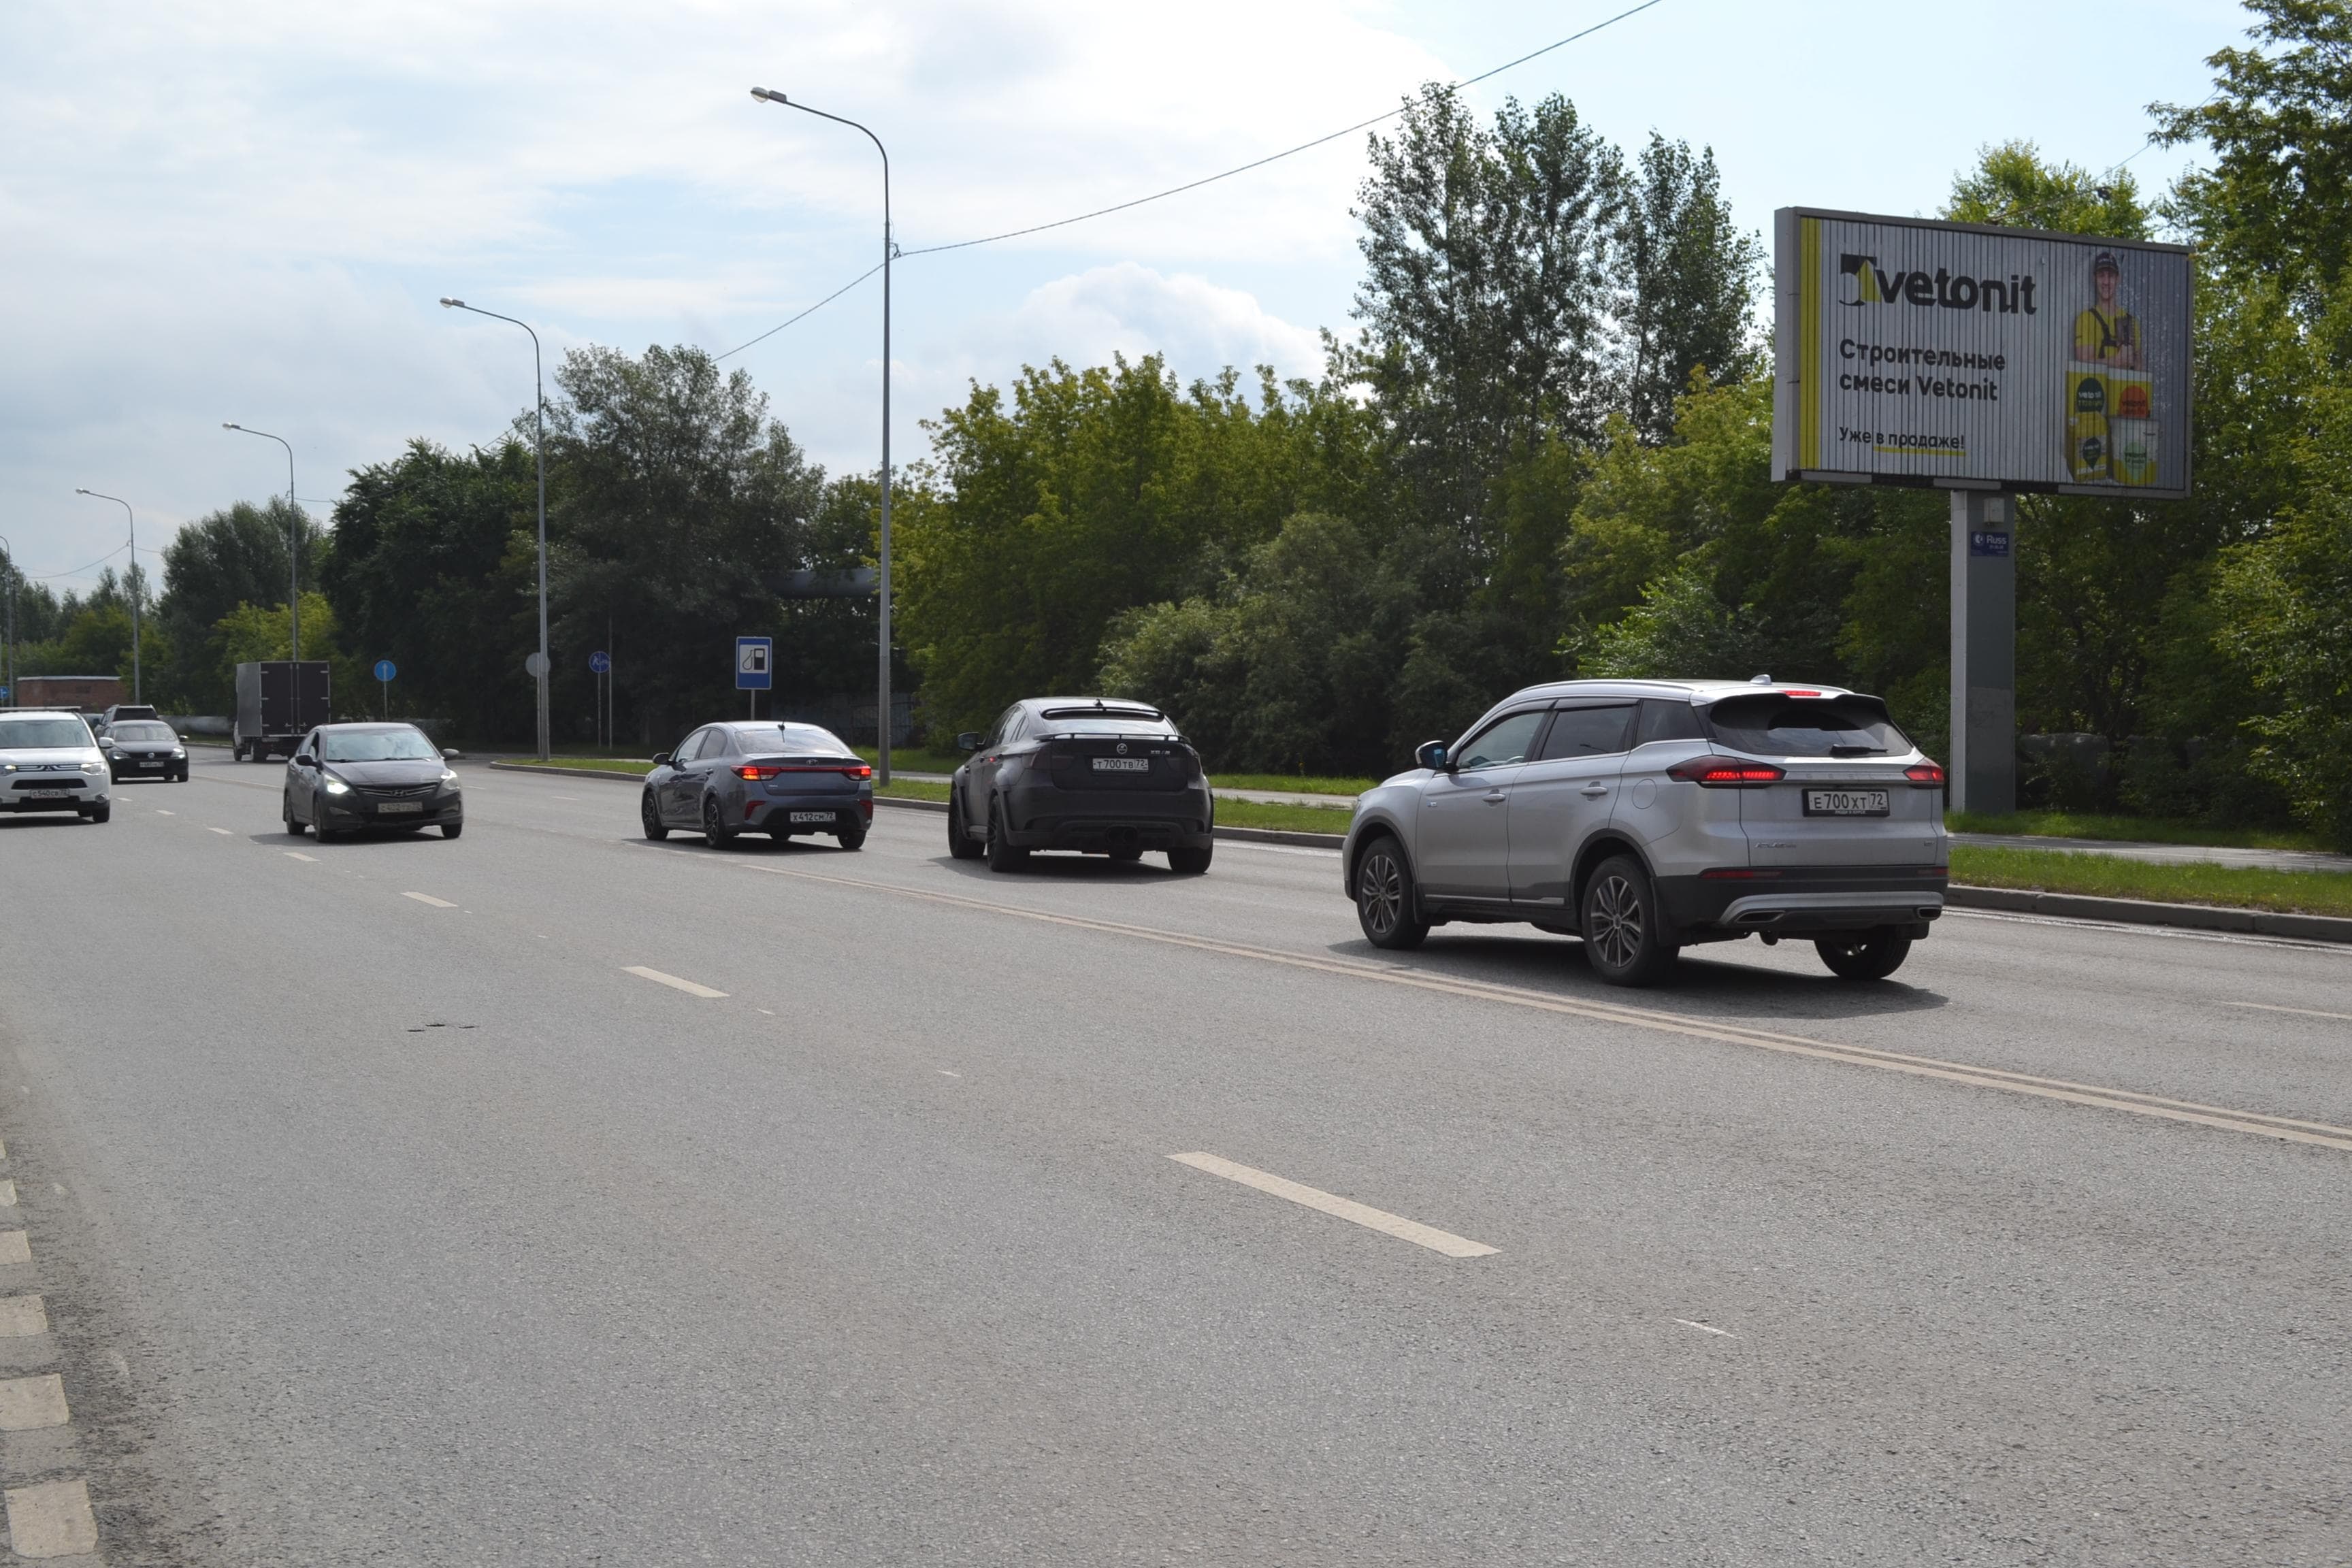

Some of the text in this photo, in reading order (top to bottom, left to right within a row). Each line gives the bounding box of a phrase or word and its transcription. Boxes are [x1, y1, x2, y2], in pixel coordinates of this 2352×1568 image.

[1875, 267, 2037, 315] vetonit
[1839, 338, 2006, 371] Строительные
[1839, 373, 1997, 401] смеси Vetonit
[1839, 426, 1965, 450] Уже в продаже!
[1987, 535, 2007, 544] Russ
